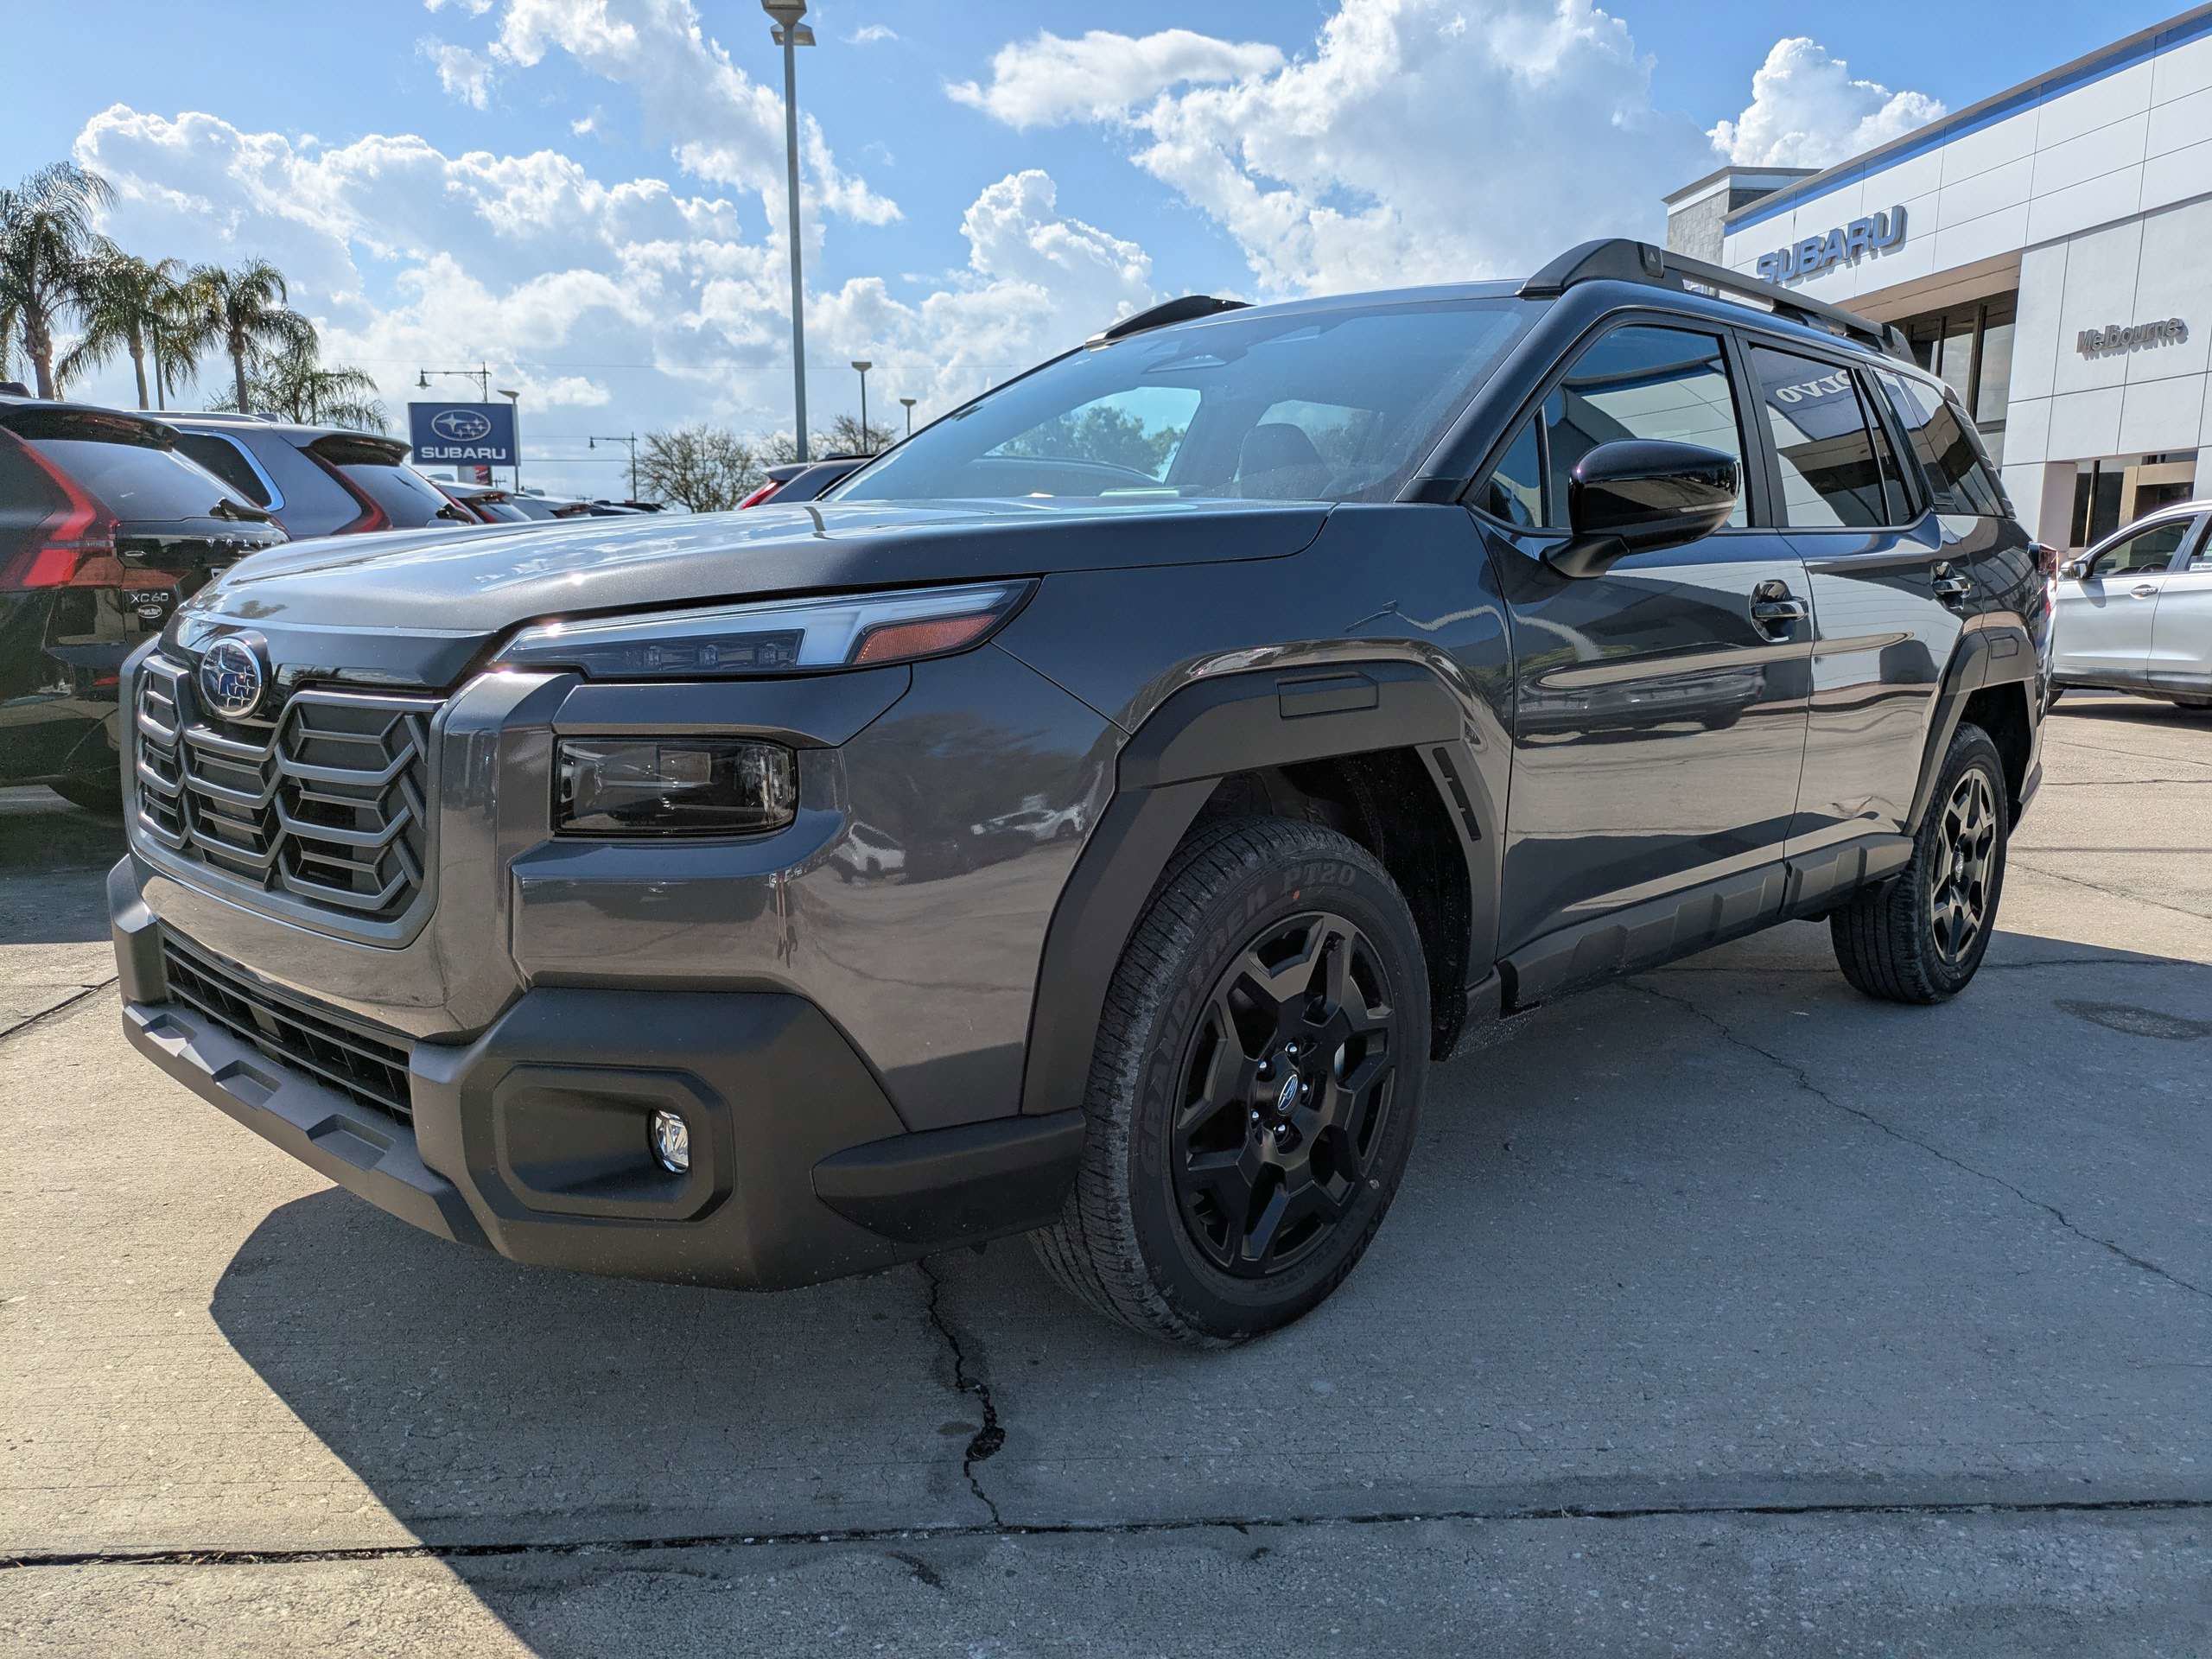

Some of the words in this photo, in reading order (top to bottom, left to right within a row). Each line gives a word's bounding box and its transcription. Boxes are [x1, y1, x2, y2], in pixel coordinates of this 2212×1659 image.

[1757, 205, 1909, 283] SUBARU
[2076, 317, 2185, 353] Melbourne
[421, 446, 506, 460] SUBARU
[130, 592, 169, 604] XC60
[1280, 861, 1358, 894] PT20
